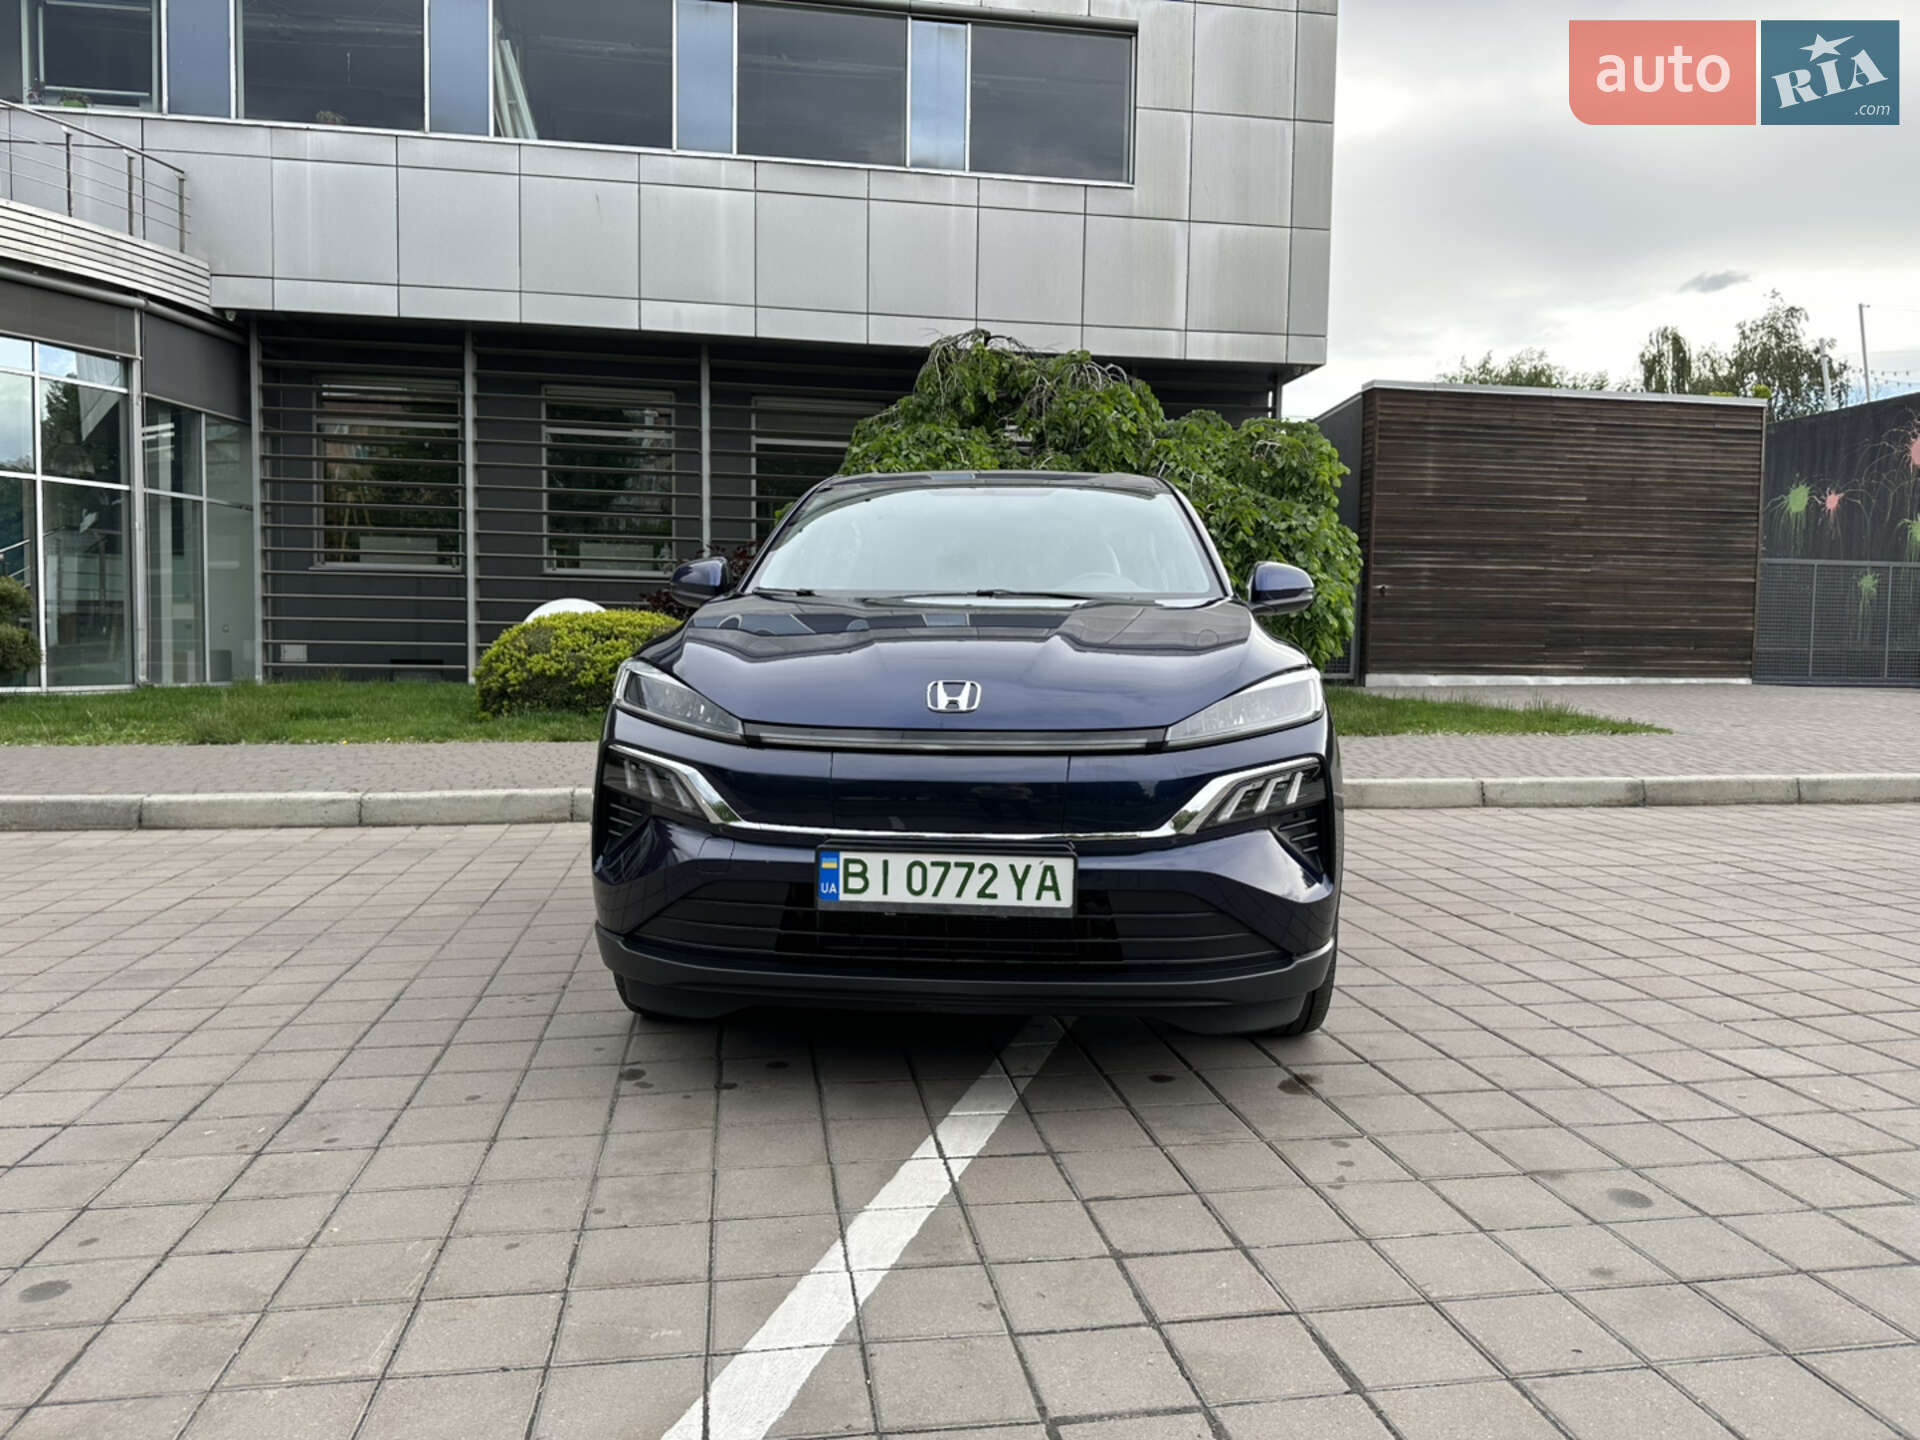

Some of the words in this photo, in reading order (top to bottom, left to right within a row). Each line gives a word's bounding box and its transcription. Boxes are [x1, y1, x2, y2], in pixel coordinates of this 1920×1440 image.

[821, 883, 838, 894] UA
[906, 860, 998, 899] 0772
[1009, 863, 1062, 901] YA
